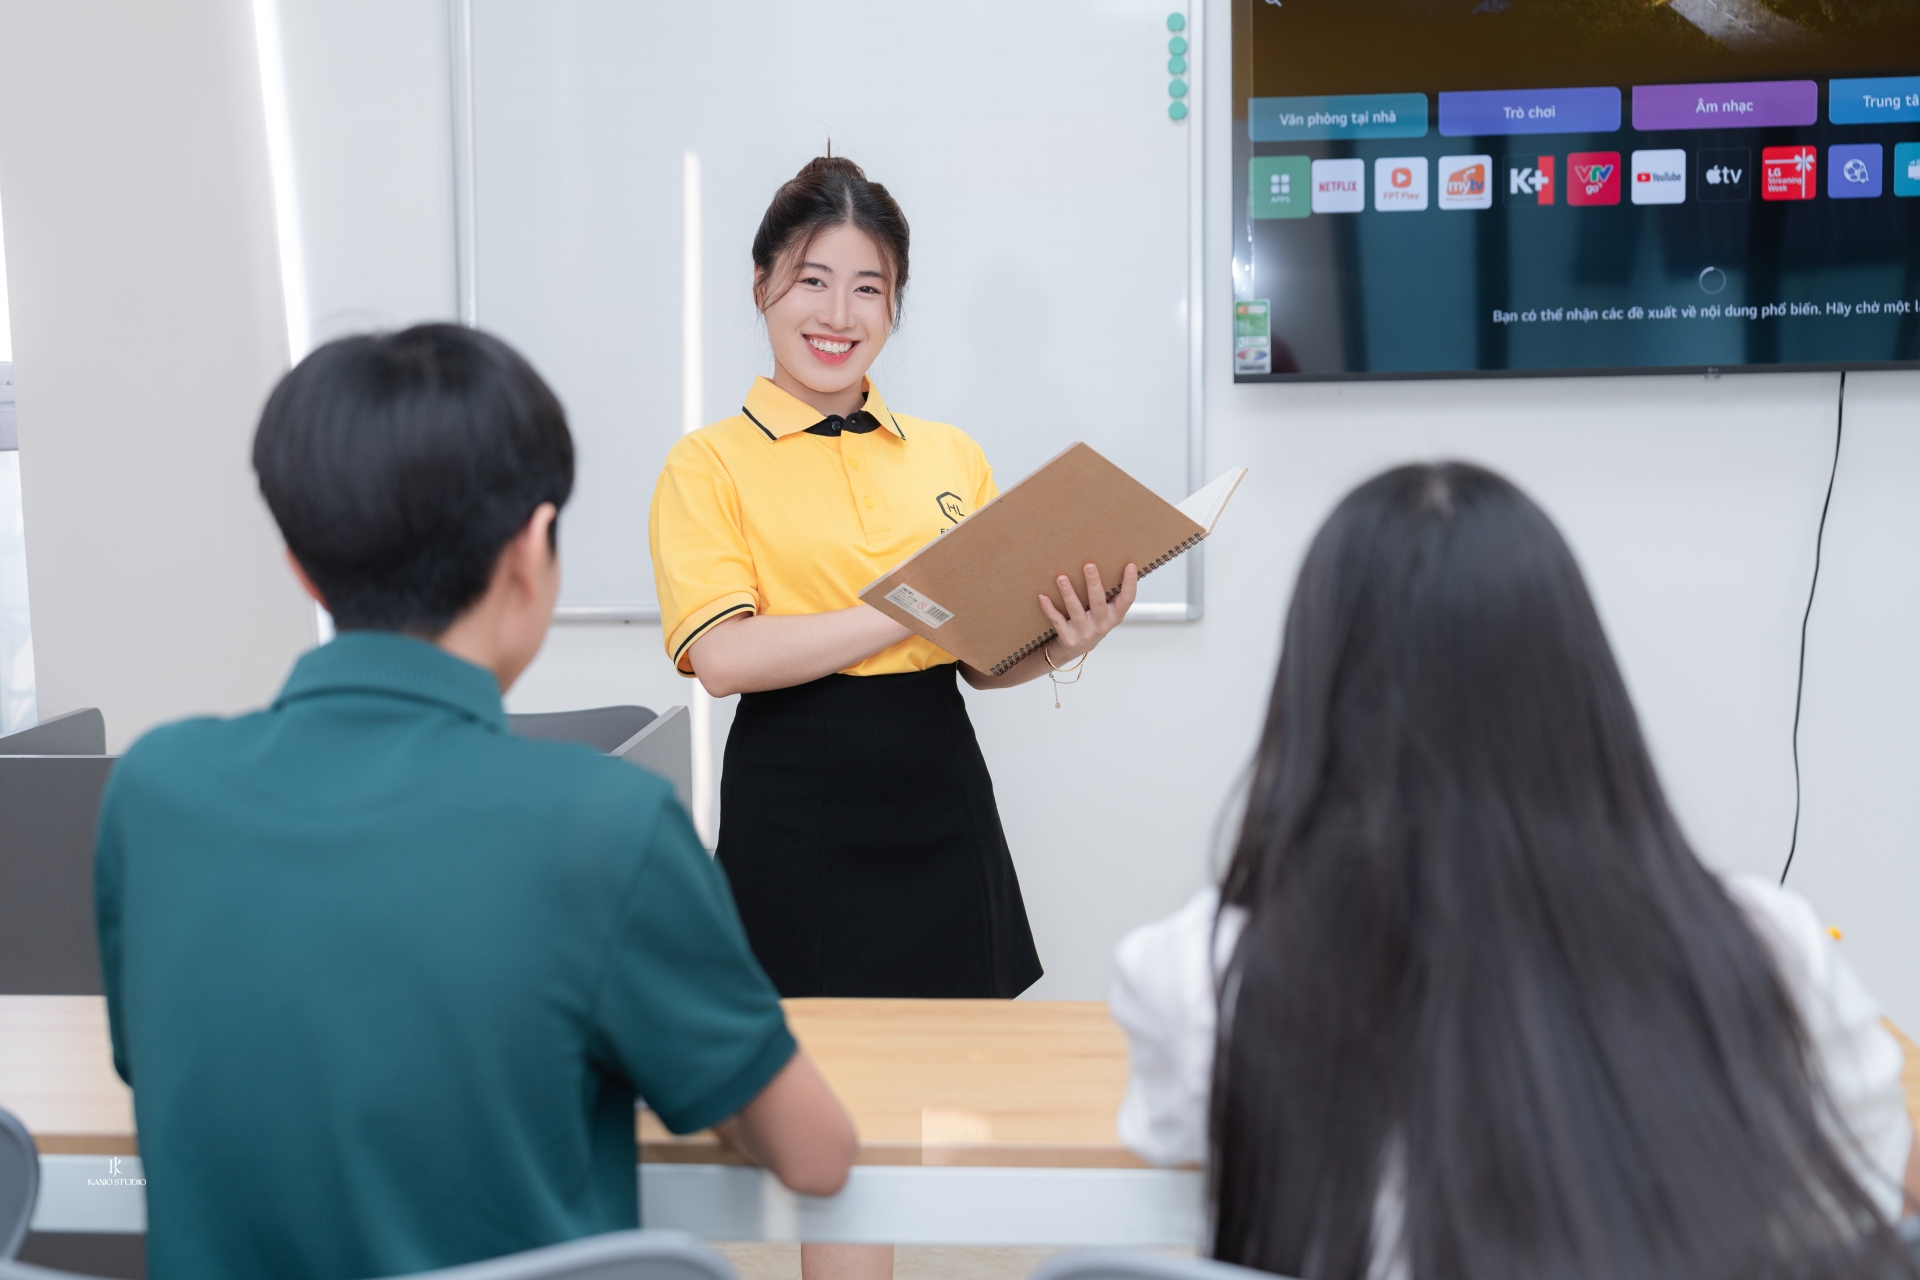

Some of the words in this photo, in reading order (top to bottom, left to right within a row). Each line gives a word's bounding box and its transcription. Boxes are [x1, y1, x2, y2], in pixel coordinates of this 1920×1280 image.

[1695, 97, 1719, 114] Âm
[1722, 98, 1754, 115] nhạc
[1862, 94, 1901, 110] Trung
[1503, 106, 1525, 119] Trò
[1528, 105, 1556, 119] chơi
[1279, 112, 1304, 126] Văn
[1307, 112, 1348, 128] phòng
[1351, 110, 1369, 127] tại
[1372, 110, 1397, 124] nhà
[1574, 164, 1614, 184] VTV
[1652, 172, 1682, 182] YouTube
[1768, 167, 1781, 177] LG
[1319, 181, 1357, 193] NETFLIX
[1510, 167, 1549, 194] K+
[1768, 176, 1802, 186] Streaming
[1768, 184, 1788, 193] Week
[1271, 195, 1291, 204] APPS
[1383, 191, 1400, 200] FPT
[1401, 191, 1420, 201] Play
[1493, 309, 1518, 325] Bạn
[1521, 308, 1537, 322] có
[1540, 306, 1563, 322] thể
[1566, 307, 1598, 324] nhận
[1602, 306, 1624, 321] các
[1627, 305, 1644, 320] đề
[1648, 304, 1677, 319] xuất
[1681, 304, 1697, 319] về
[1701, 304, 1720, 320] nội
[1725, 304, 1757, 320] dung
[1761, 302, 1787, 320] phổ
[1790, 301, 1822, 316] biến.
[1826, 301, 1852, 317] Hãy
[1856, 300, 1880, 315] chờ
[1884, 299, 1910, 315] một
